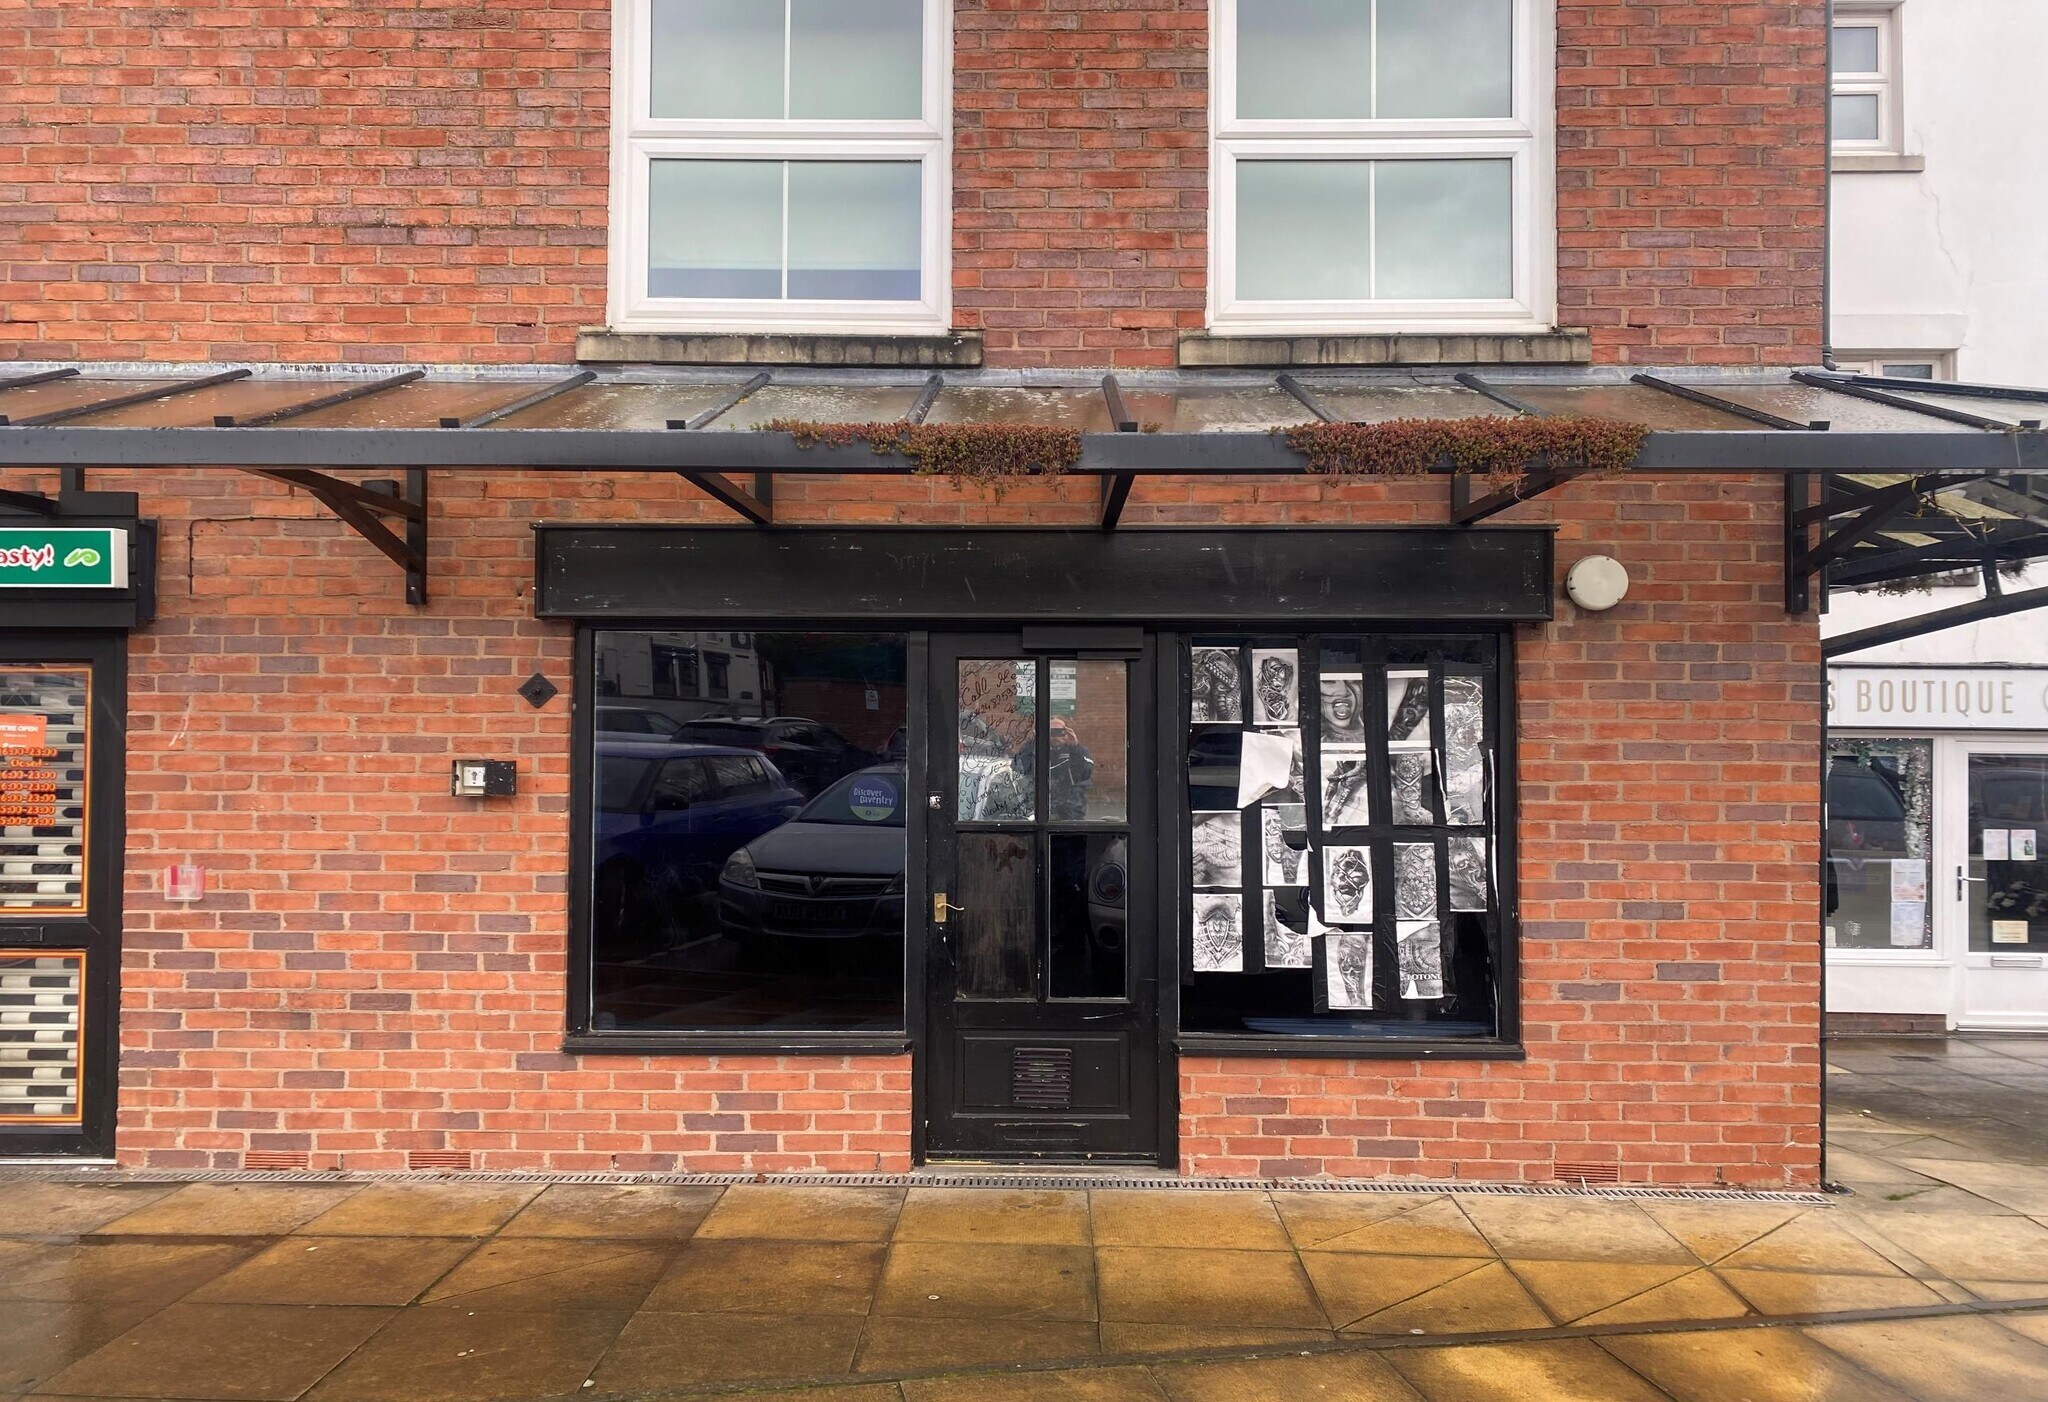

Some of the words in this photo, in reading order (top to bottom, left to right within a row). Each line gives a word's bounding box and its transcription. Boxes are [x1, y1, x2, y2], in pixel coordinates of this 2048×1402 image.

[962, 677, 991, 706] Call
[1856, 679, 2014, 717] BOUTIQUE
[853, 787, 883, 797] Discover
[859, 796, 894, 806] Daventry
